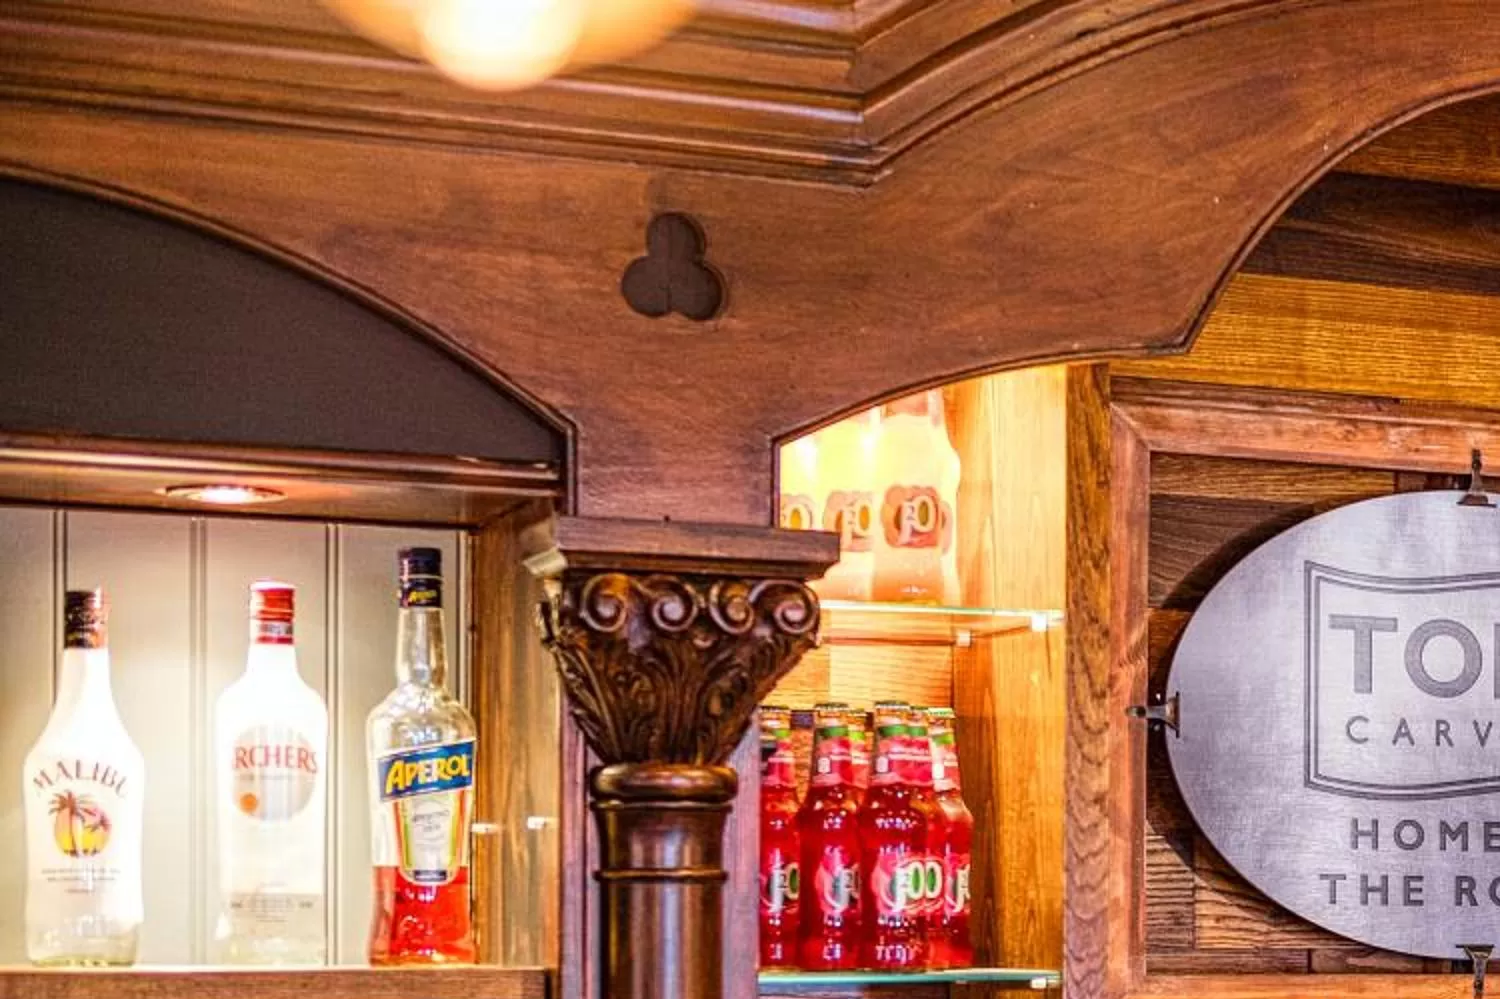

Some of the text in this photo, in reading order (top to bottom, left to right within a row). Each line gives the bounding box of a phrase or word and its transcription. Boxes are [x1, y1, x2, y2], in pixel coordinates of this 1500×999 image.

[234, 744, 318, 774] RCHERS
[385, 752, 469, 794] APEROL
[1320, 873, 1424, 906] THE
